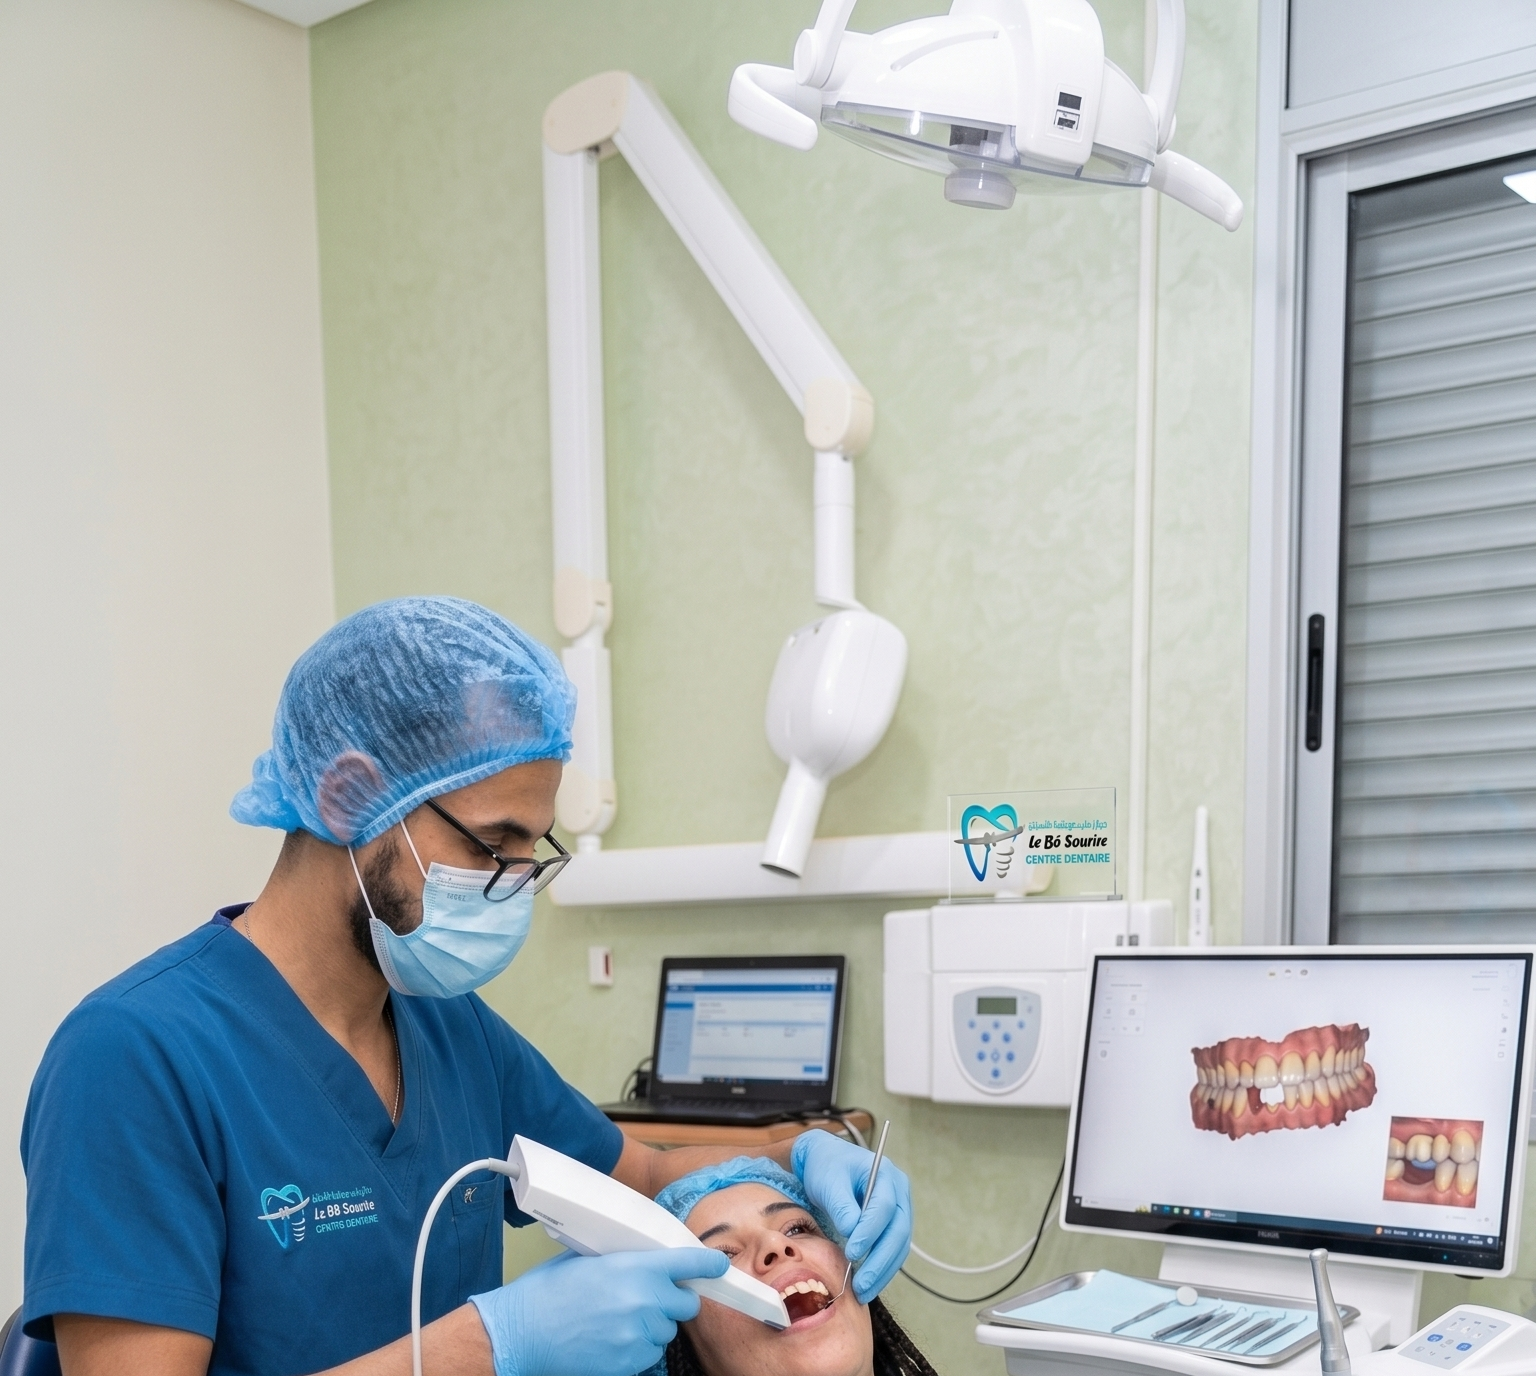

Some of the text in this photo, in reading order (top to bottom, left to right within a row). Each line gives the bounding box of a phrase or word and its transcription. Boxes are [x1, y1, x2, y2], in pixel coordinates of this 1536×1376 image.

[1064, 834, 1108, 848] Sourire
[1025, 853, 1111, 865] CENTRE DENTAIRE
